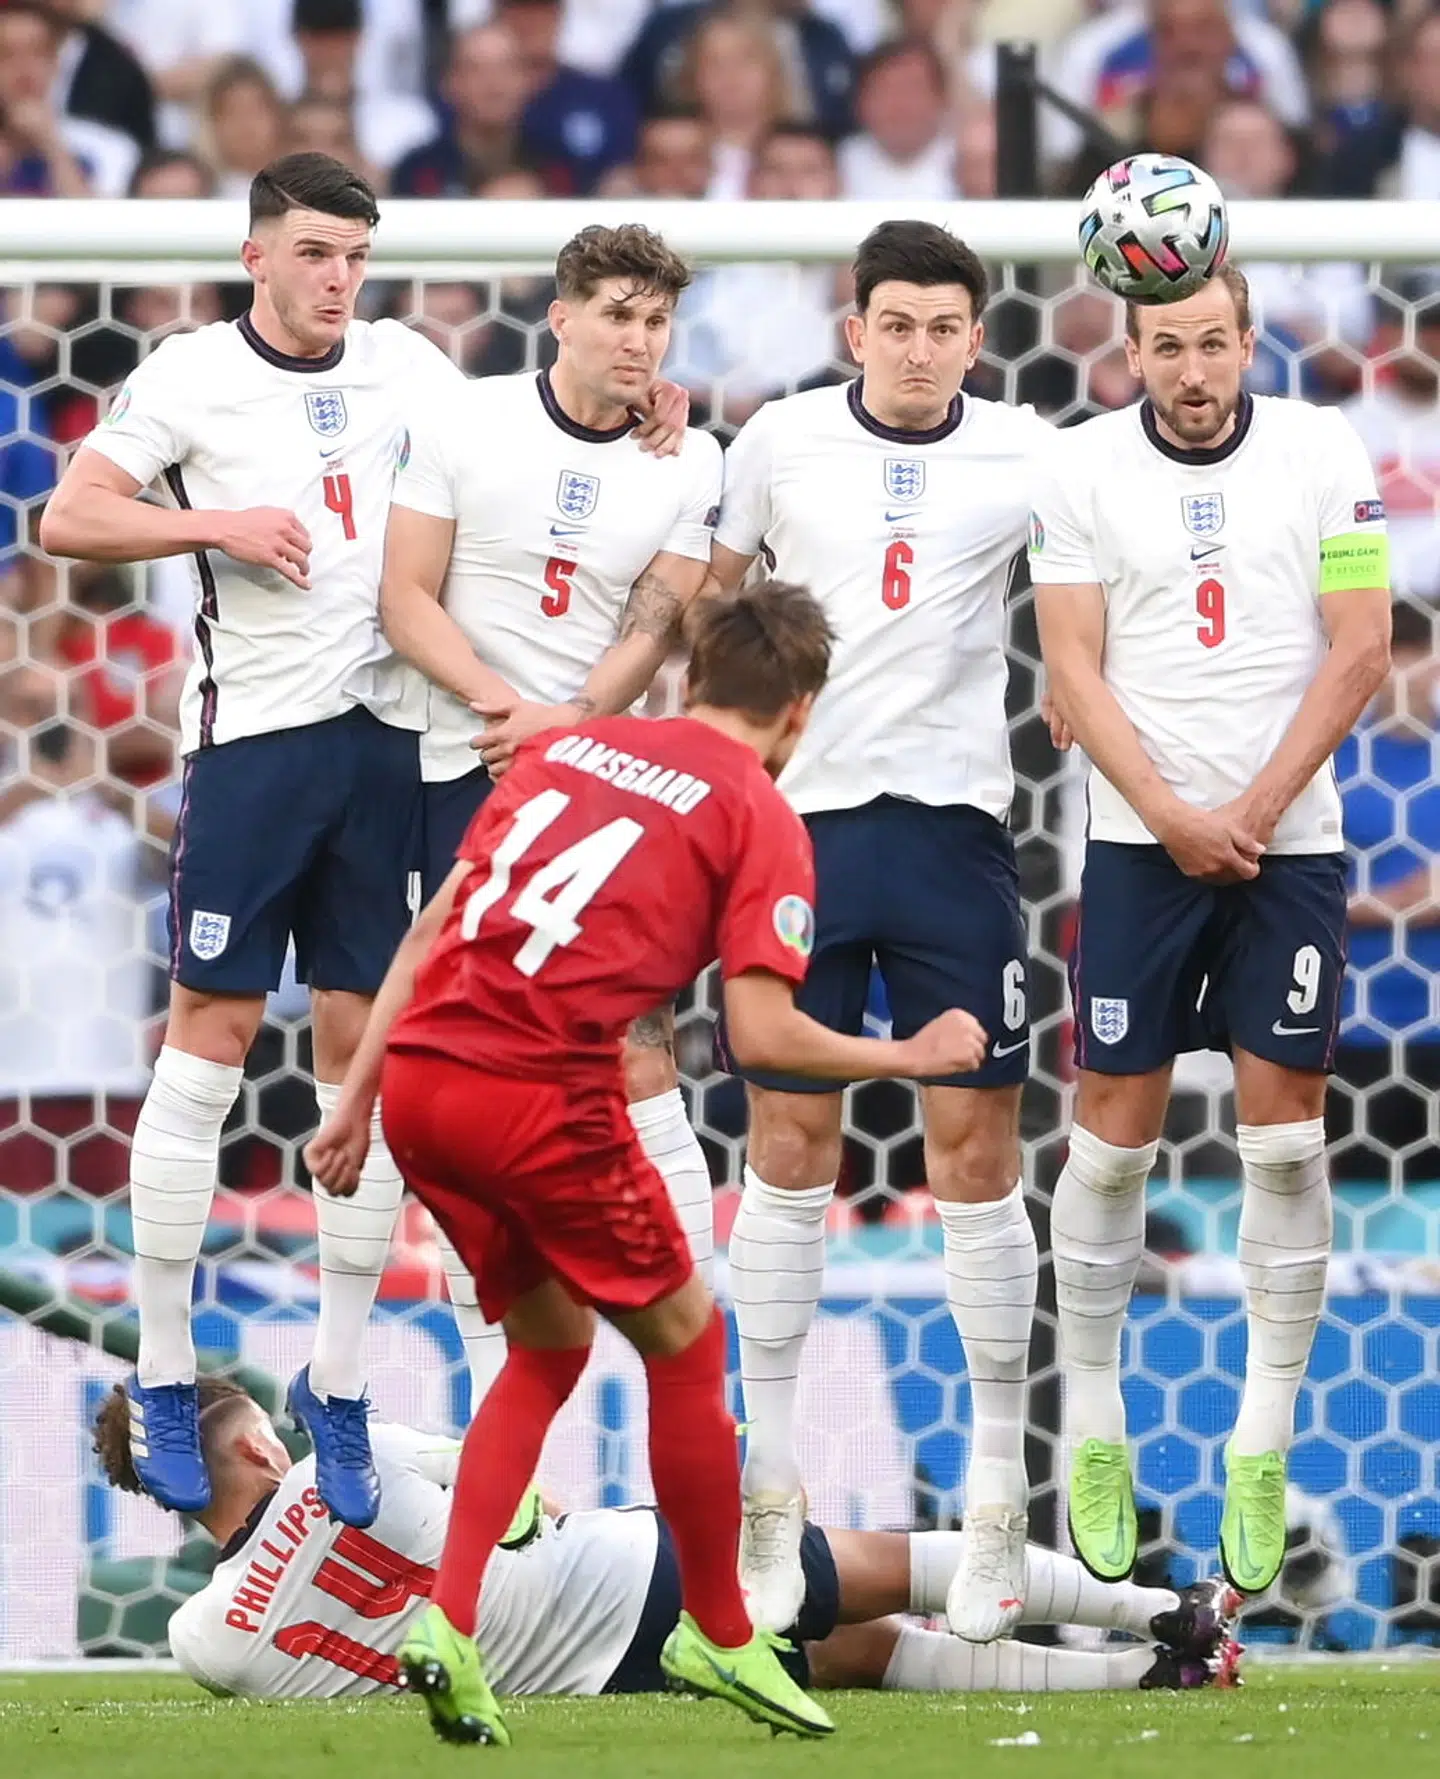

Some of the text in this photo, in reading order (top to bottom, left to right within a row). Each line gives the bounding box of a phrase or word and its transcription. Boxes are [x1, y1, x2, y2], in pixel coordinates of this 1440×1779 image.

[323, 474, 357, 540] 4
[540, 555, 578, 618] 5
[881, 540, 913, 611] 6
[1196, 578, 1225, 648] 9
[543, 735, 712, 816] DAMSGAARD
[460, 788, 645, 978] 14
[1002, 958, 1026, 1032] 6
[1286, 944, 1322, 1015] 9
[225, 1486, 330, 1634] PHILLIPS
[272, 1524, 436, 1689] 14
